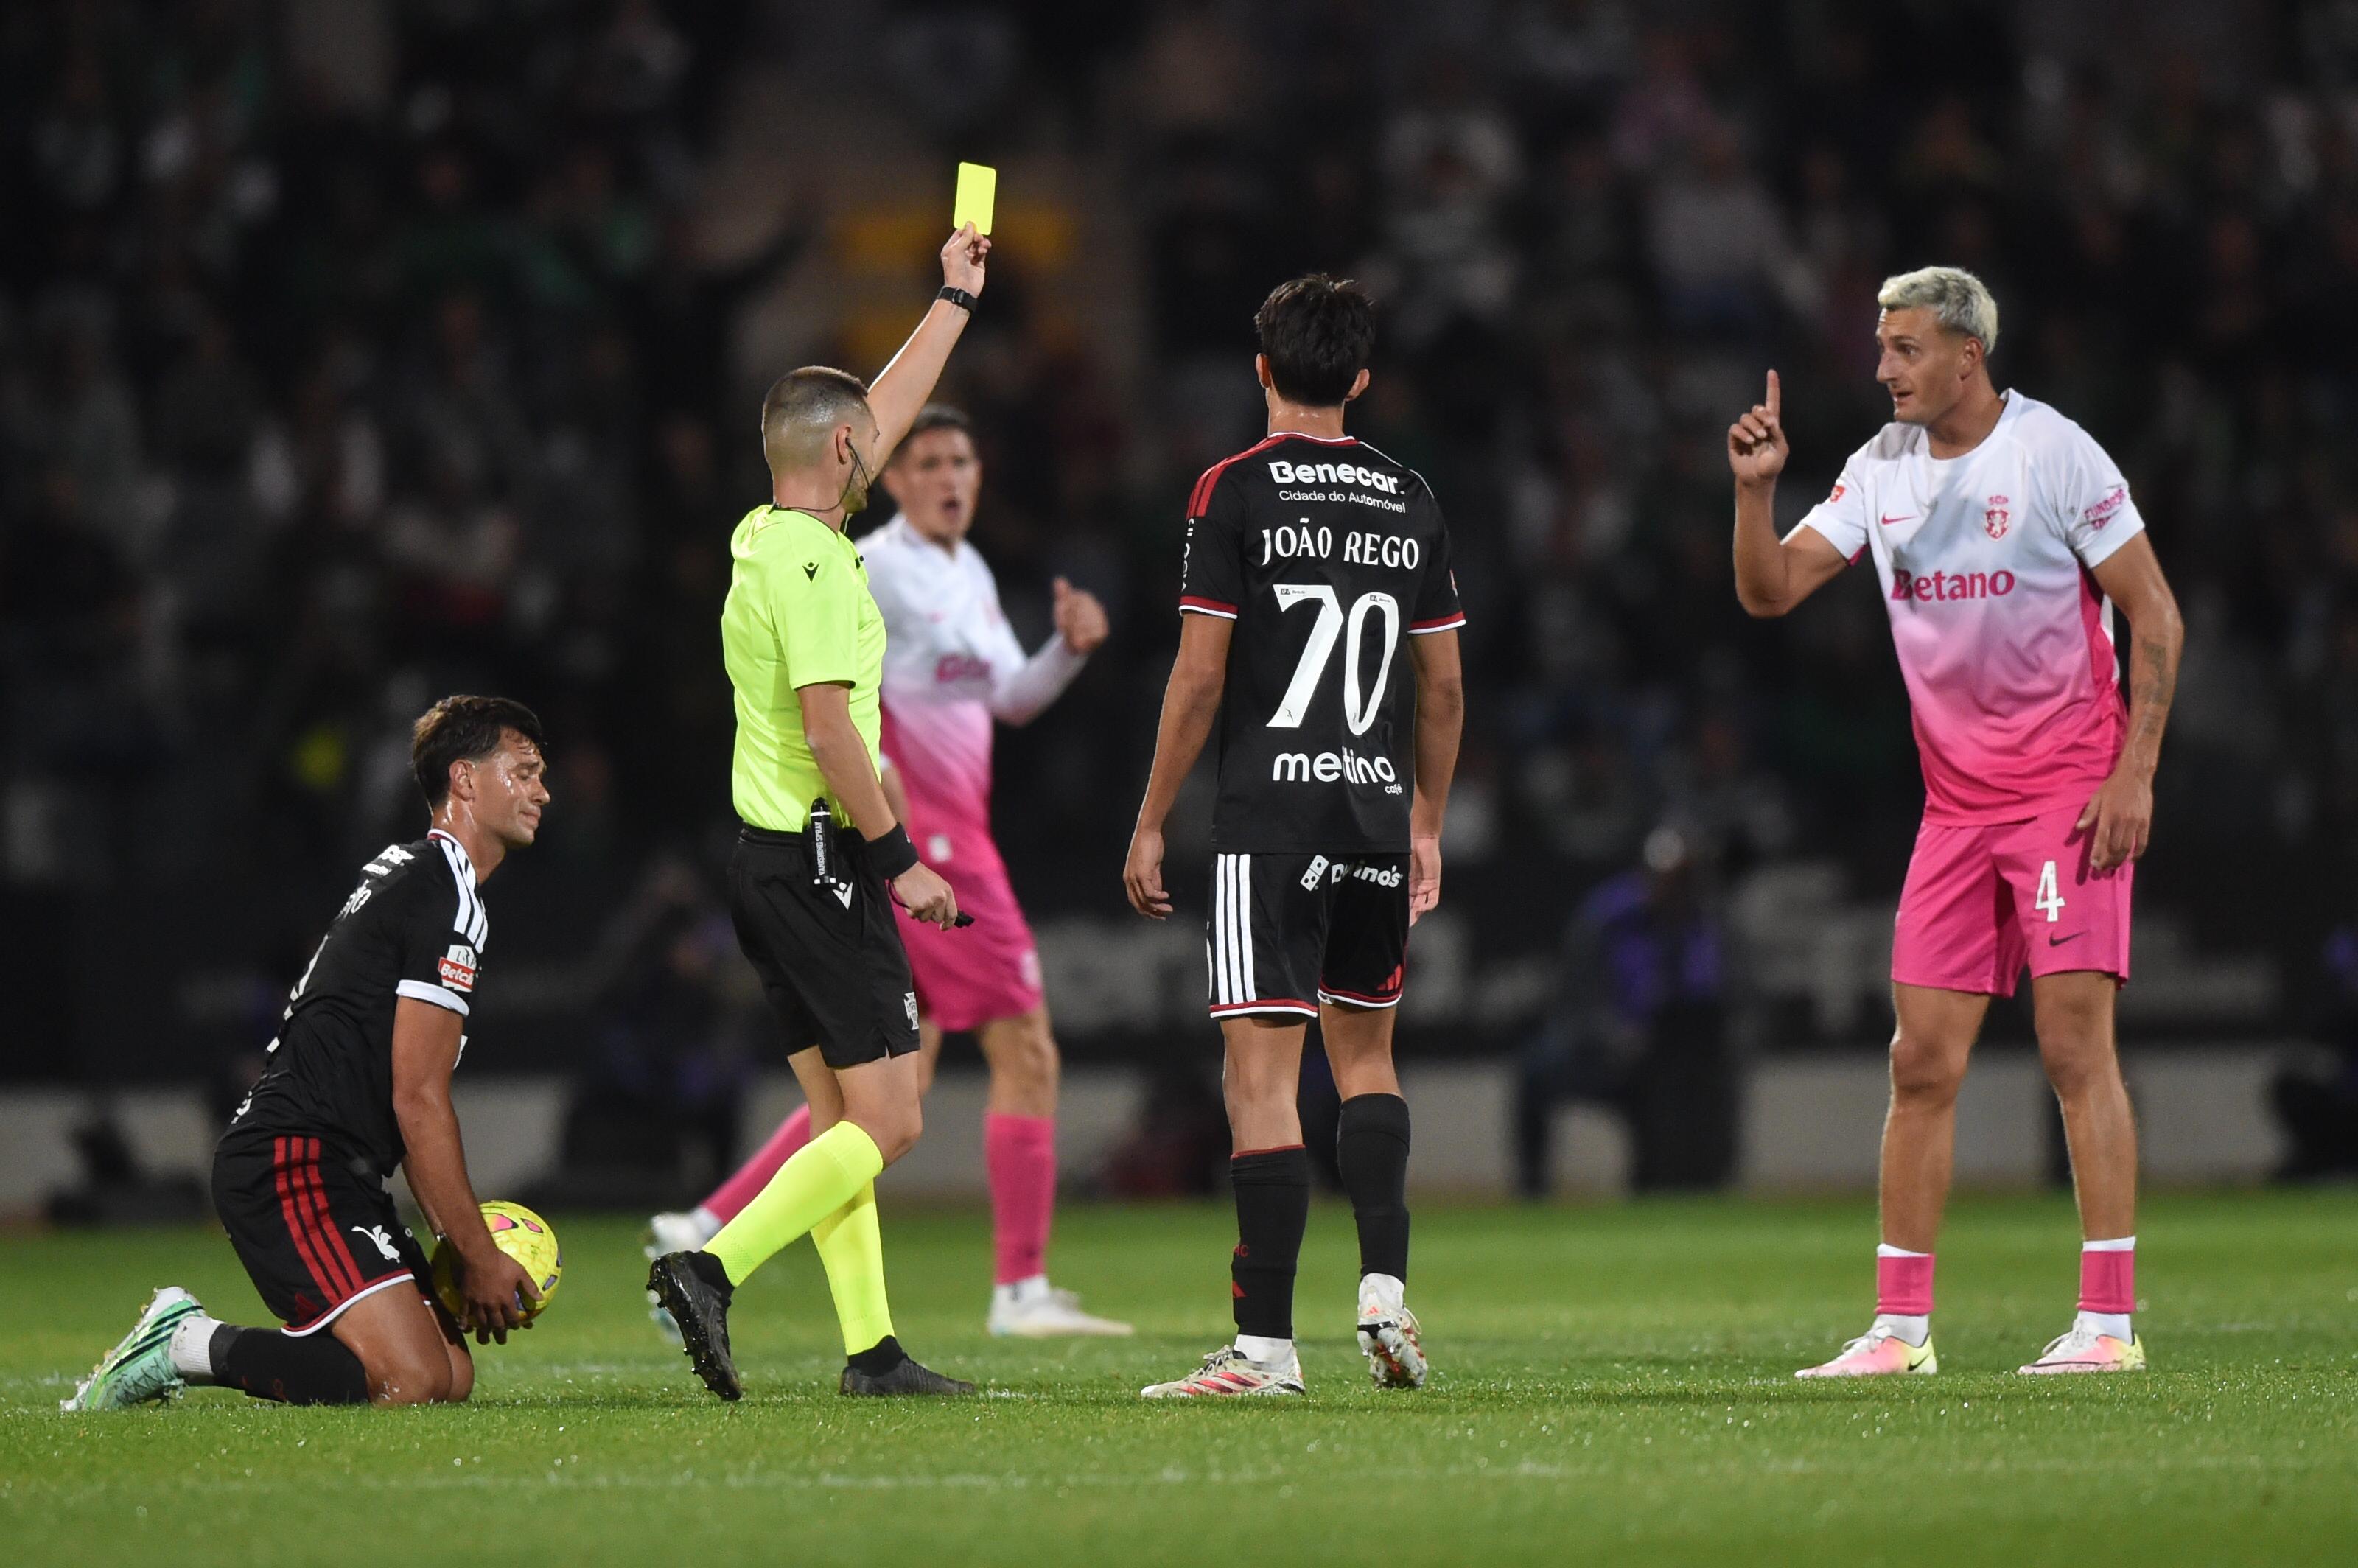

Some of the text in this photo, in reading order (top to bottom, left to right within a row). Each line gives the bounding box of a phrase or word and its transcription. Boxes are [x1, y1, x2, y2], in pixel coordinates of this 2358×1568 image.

[1268, 461, 1399, 494] Benecar
[1279, 490, 1406, 514] Cidade do Automóvel
[1262, 517, 1419, 570] JOÃO REGO
[1892, 569, 2015, 602] Betano
[1266, 584, 1400, 736] 70
[1331, 862, 1402, 888] Dino's
[2035, 861, 2065, 922] 4
